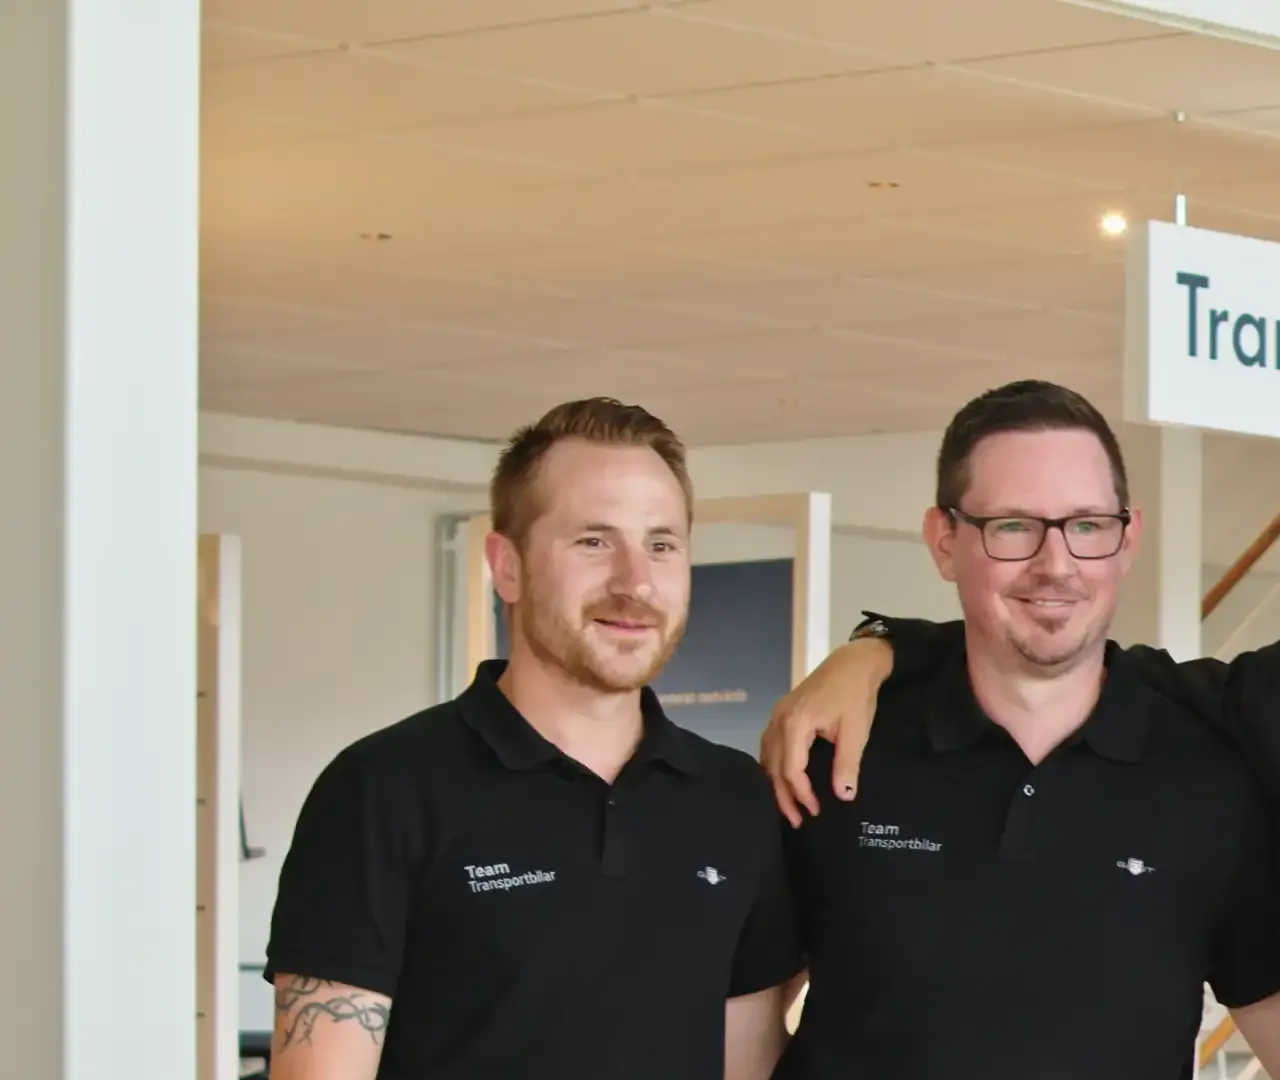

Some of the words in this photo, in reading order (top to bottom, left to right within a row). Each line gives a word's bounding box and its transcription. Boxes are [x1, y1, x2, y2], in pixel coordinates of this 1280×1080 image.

[860, 821, 899, 836] Team
[857, 835, 943, 852] Transportbilar
[463, 862, 511, 879] Team
[467, 869, 556, 893] Transportbilar
